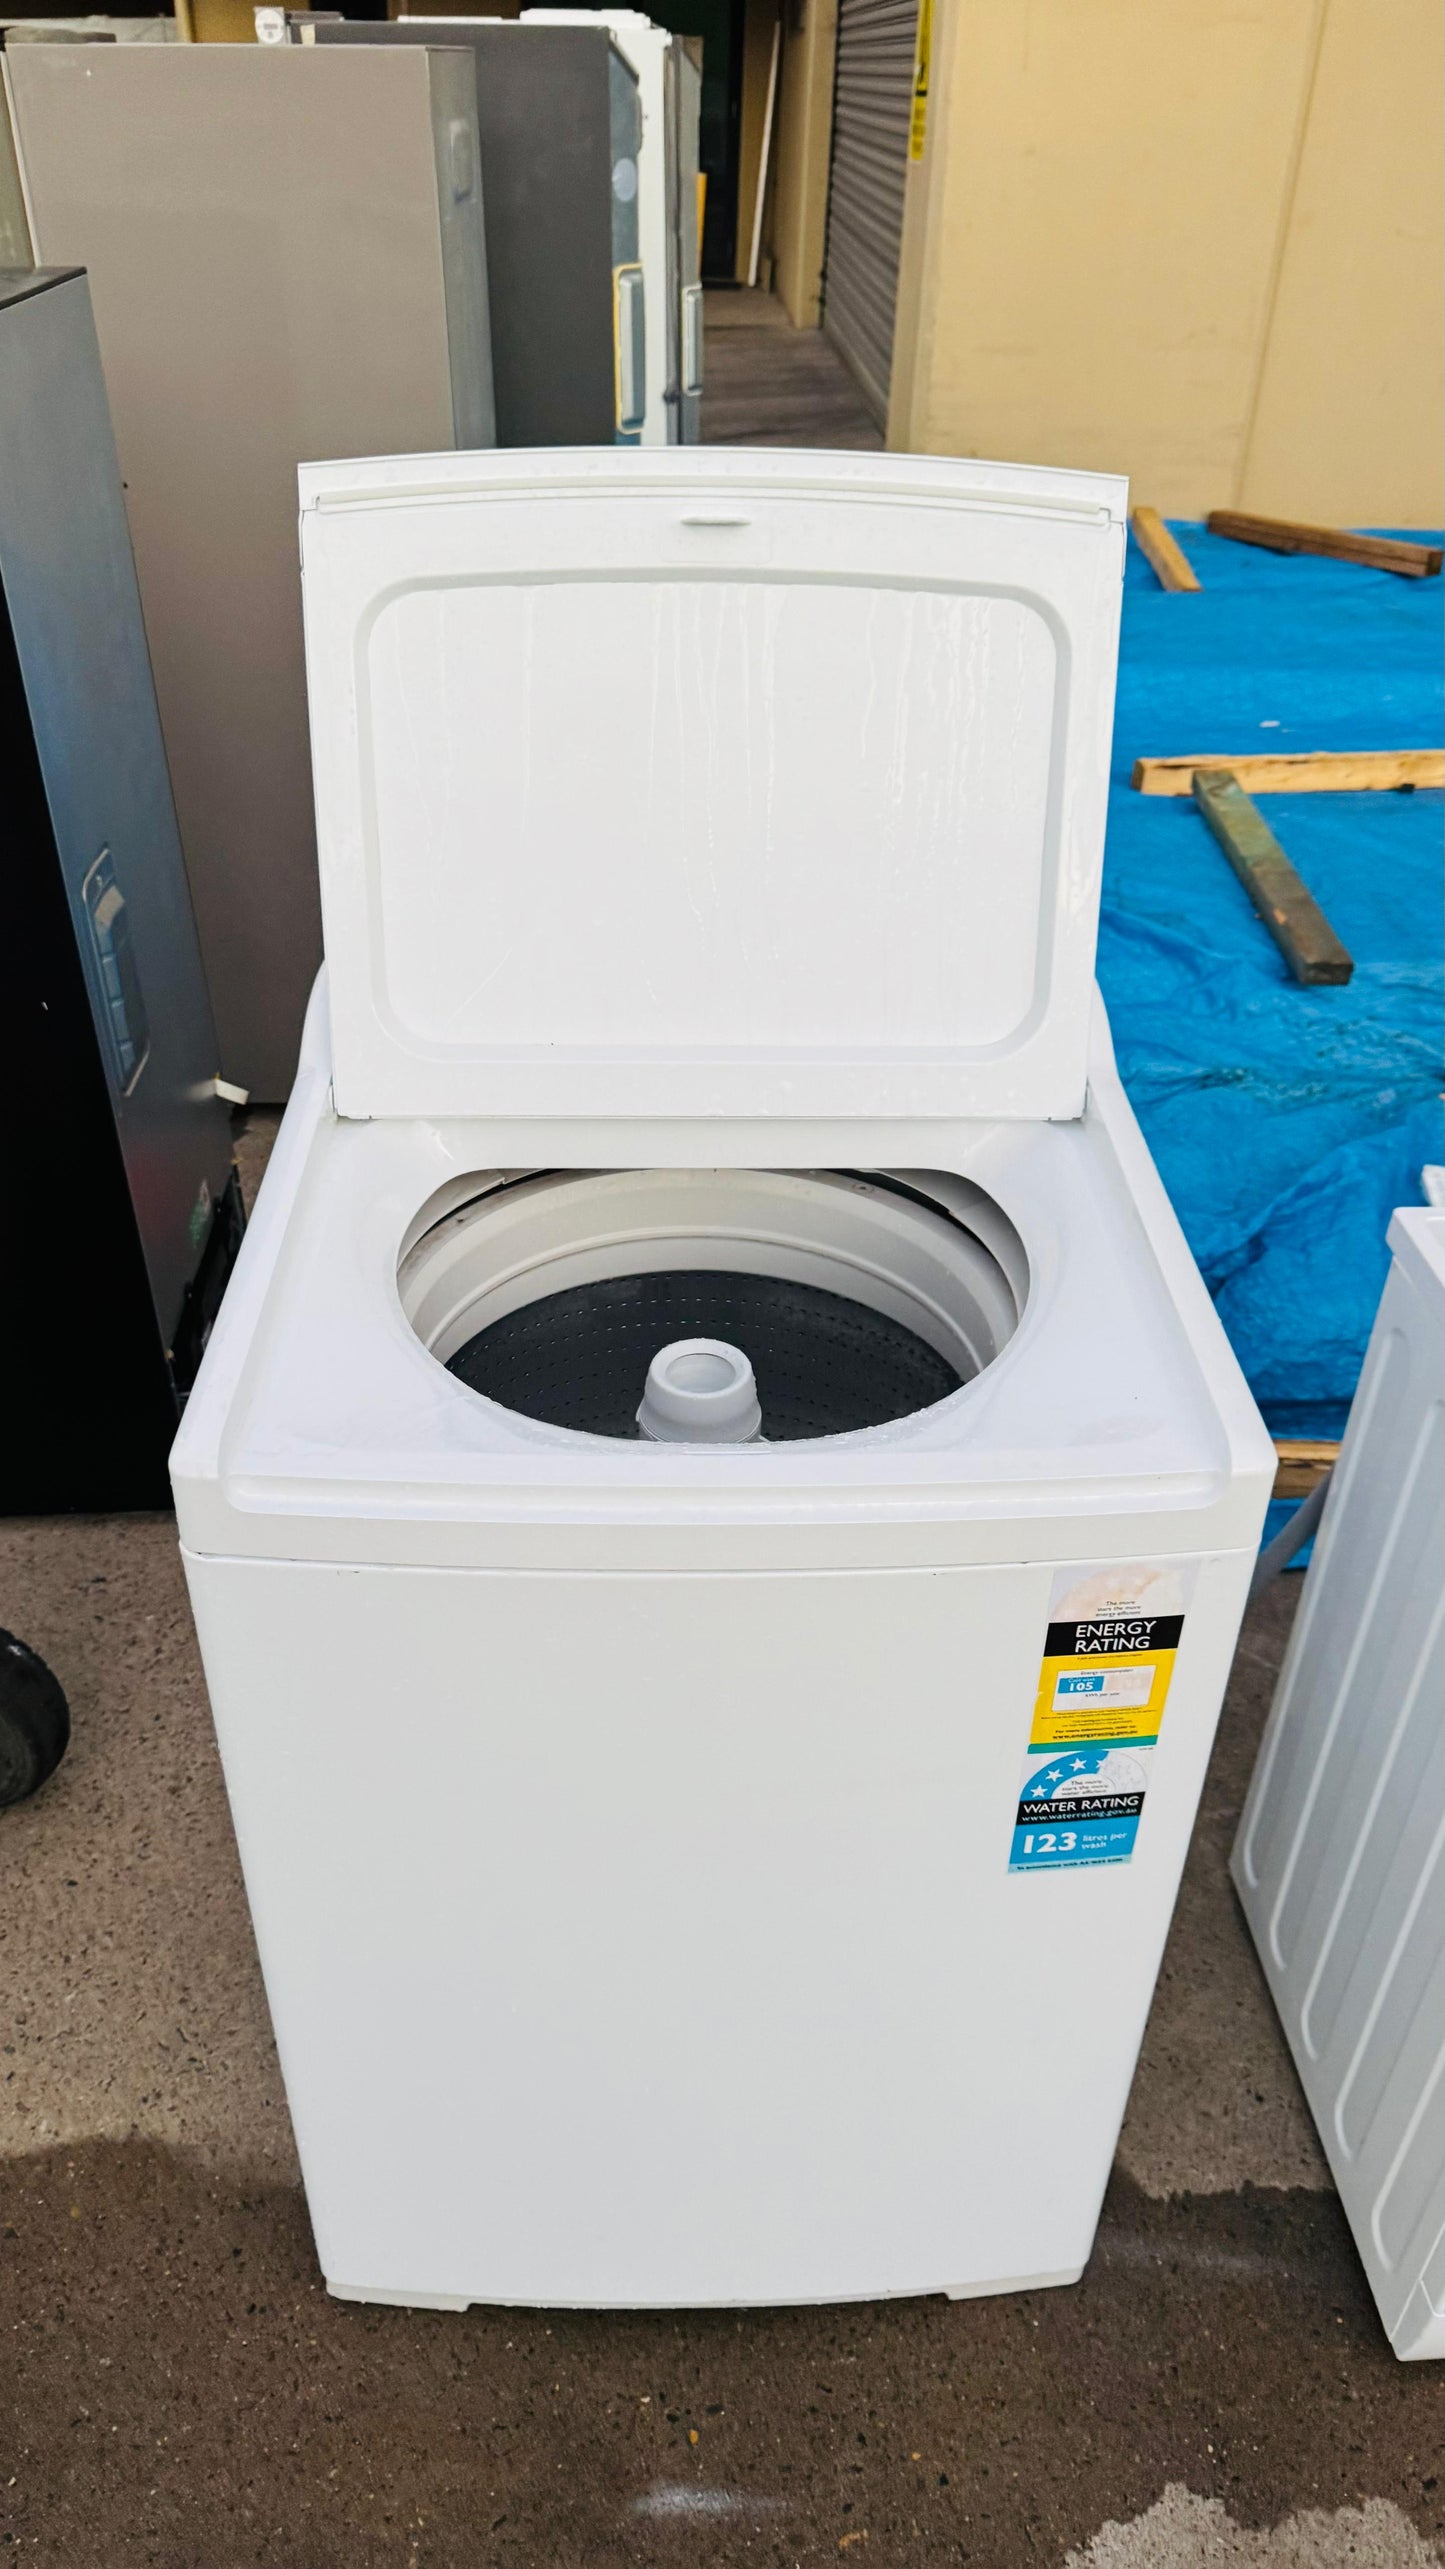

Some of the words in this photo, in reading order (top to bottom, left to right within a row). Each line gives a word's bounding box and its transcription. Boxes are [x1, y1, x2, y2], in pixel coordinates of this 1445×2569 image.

[1076, 1621, 1156, 1638] ENERGY
[1075, 1636, 1151, 1653] RATING
[1069, 1681, 1094, 1692] 105
[1023, 1801, 1077, 1814] WATER
[1081, 1795, 1140, 1810] RATING
[1022, 1808, 1137, 1822] www.waterrating.gov.au
[1023, 1832, 1078, 1854] 123
[1082, 1833, 1108, 1842] litres
[1110, 1832, 1127, 1841] per
[1081, 1841, 1107, 1850] wash
